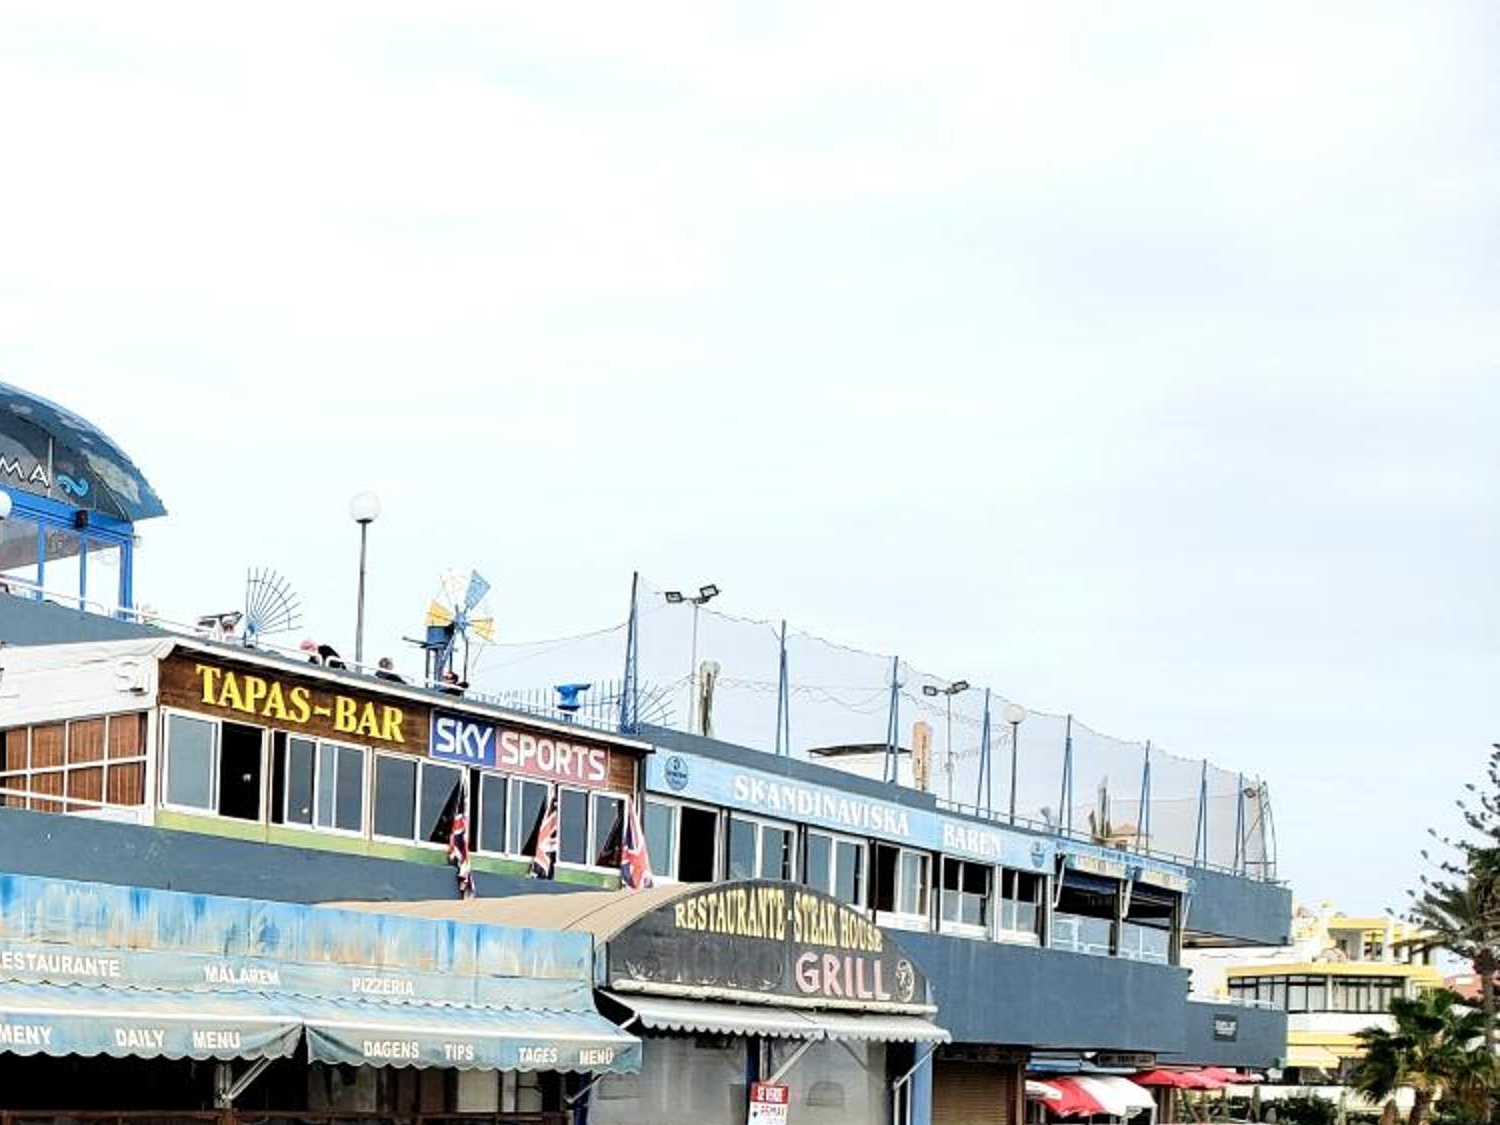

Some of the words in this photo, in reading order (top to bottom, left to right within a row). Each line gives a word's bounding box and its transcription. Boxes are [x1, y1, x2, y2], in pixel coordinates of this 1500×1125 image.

[435, 717, 494, 759] SKY
[501, 730, 606, 781] SPORTS
[732, 774, 911, 836] SKANDINAVISKA
[675, 888, 785, 940] RESTAURANTE
[794, 891, 837, 947] STEAK
[840, 906, 883, 953] HOUSE
[351, 976, 415, 996] PIZZERIA
[795, 952, 891, 999] GRILL
[116, 1027, 165, 1047] DAILY
[192, 1030, 241, 1050] MENU
[363, 1040, 419, 1059] DAGENS
[443, 1043, 474, 1061] TIPS
[517, 1047, 558, 1063] TAGES
